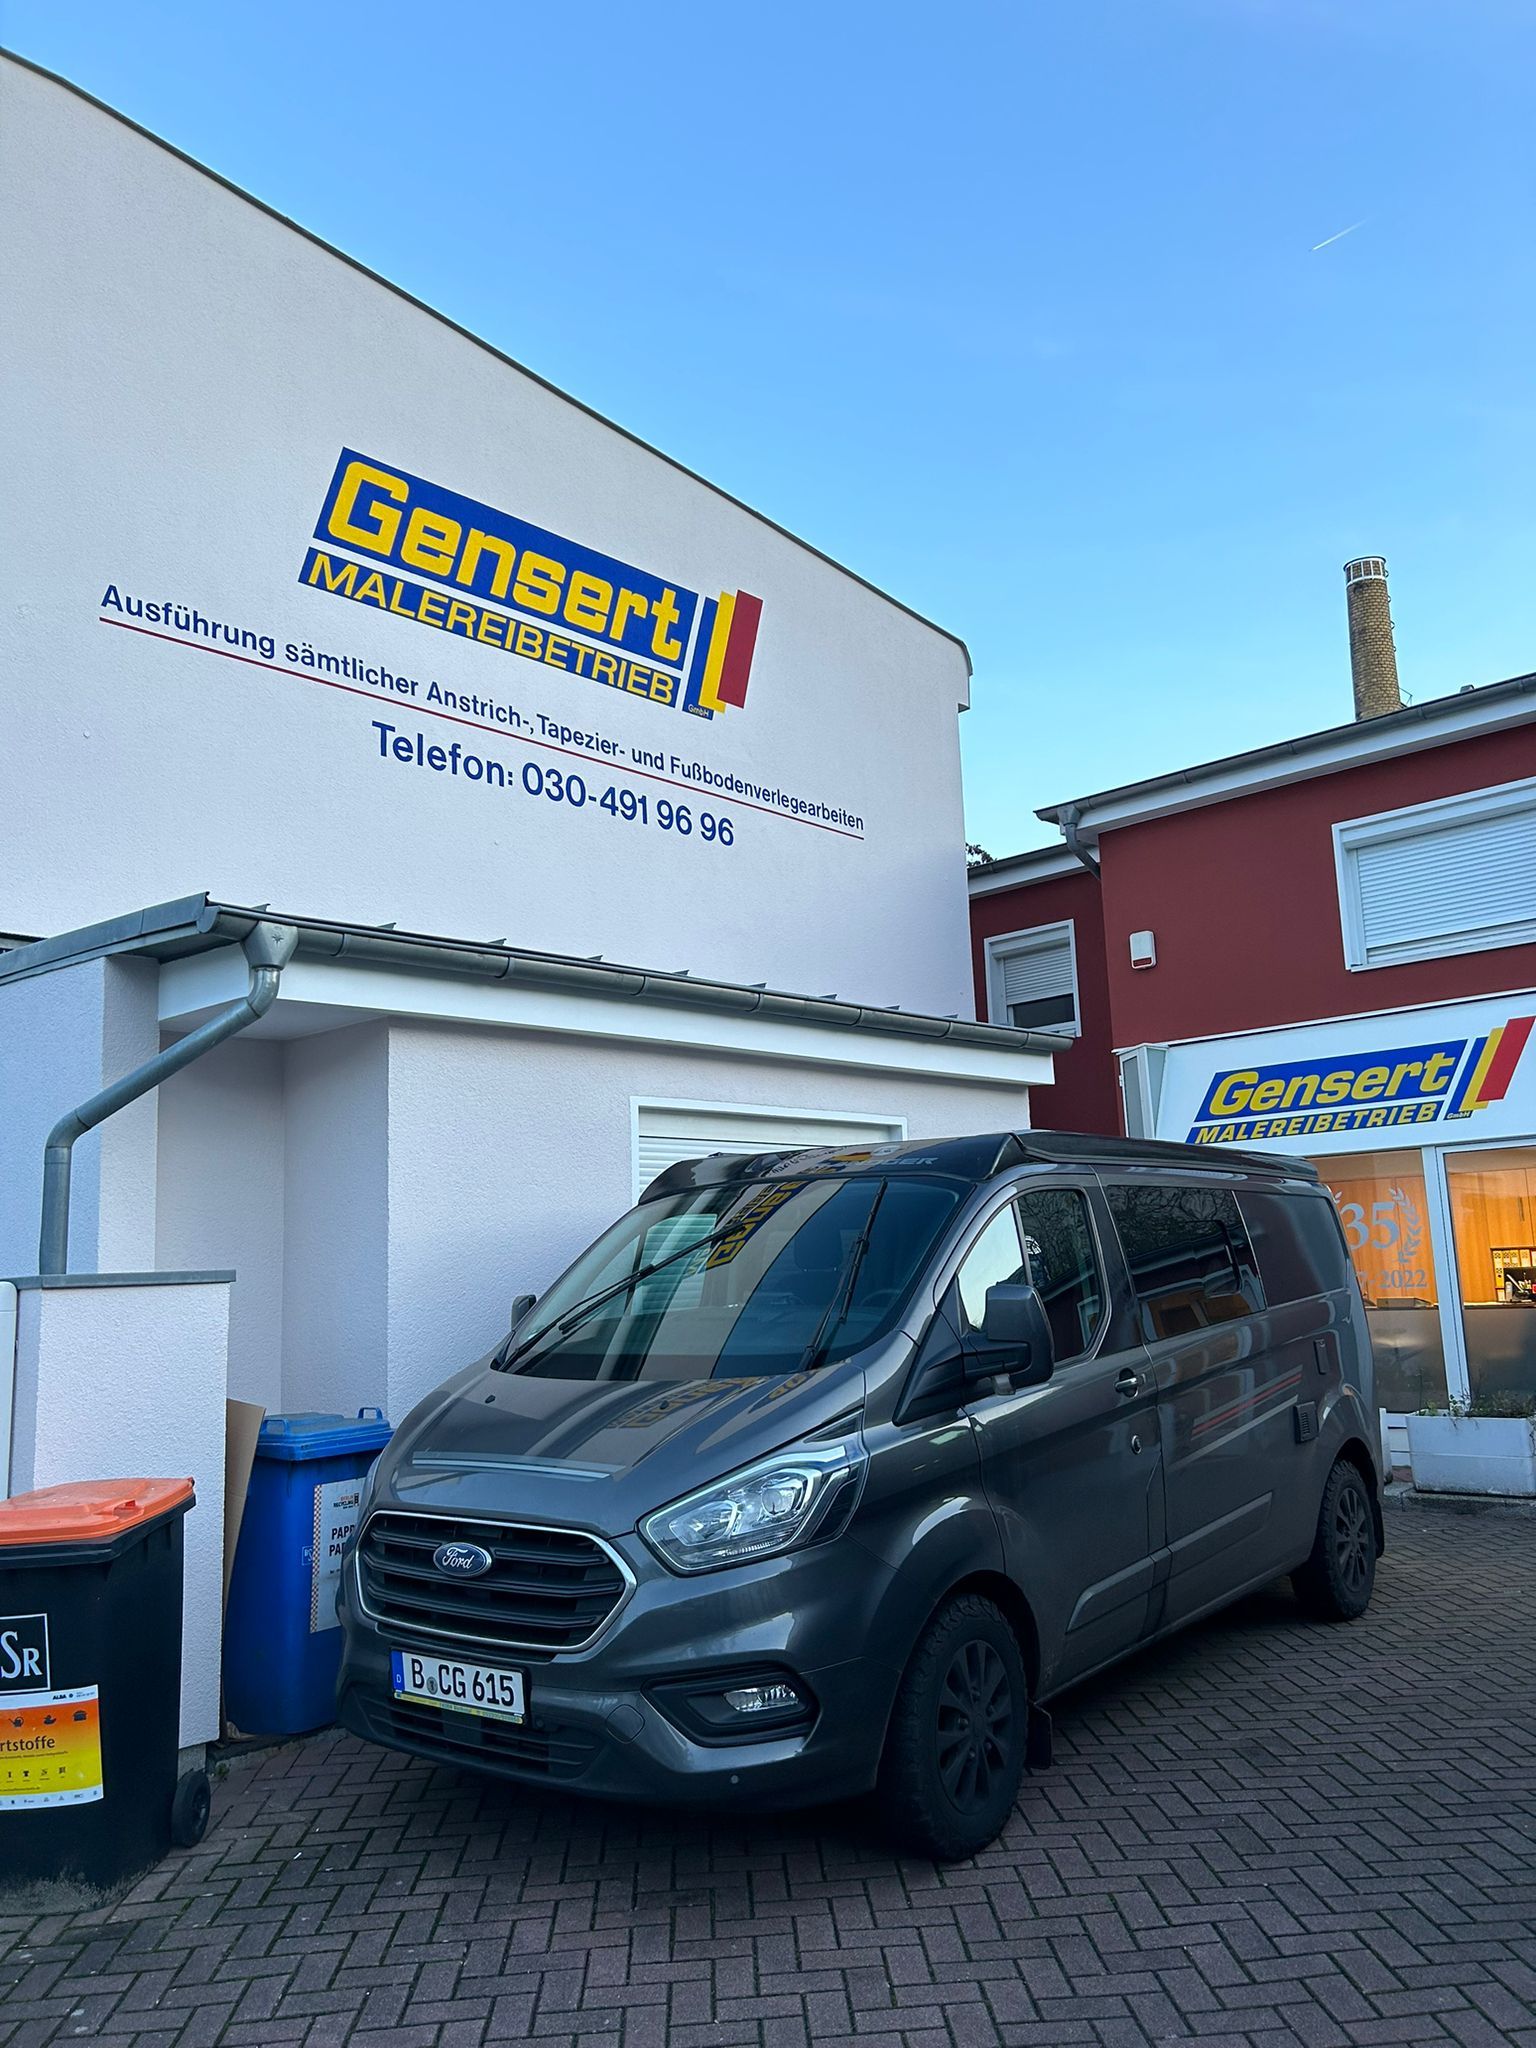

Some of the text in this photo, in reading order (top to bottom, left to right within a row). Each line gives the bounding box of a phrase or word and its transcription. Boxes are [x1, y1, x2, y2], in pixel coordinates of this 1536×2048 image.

[328, 461, 683, 662] Gensert
[308, 553, 675, 704] MALEREIBETRIEB
[101, 584, 275, 659] Ausführung
[285, 642, 419, 696] sämtlicher
[536, 714, 626, 756] Tapezier-
[632, 747, 664, 771] und
[671, 756, 864, 831] Fußbodenverlegearbeiten
[688, 703, 710, 718] GmbH
[372, 720, 734, 846] Telefon: 030-491 96 96
[1209, 1052, 1456, 1116] Gensert
[1194, 1102, 1438, 1144] MALEREIBETRIEB
[1447, 1110, 1471, 1120] GmbH
[1340, 1201, 1400, 1250] 35
[331, 1524, 356, 1540] PAPP
[442, 1546, 476, 1570] Ford
[0, 1631, 43, 1679] SR
[411, 1657, 425, 1689] B
[438, 1663, 467, 1699] CG
[472, 1670, 515, 1707] 615
[0, 1735, 56, 1752] rtstoffe
